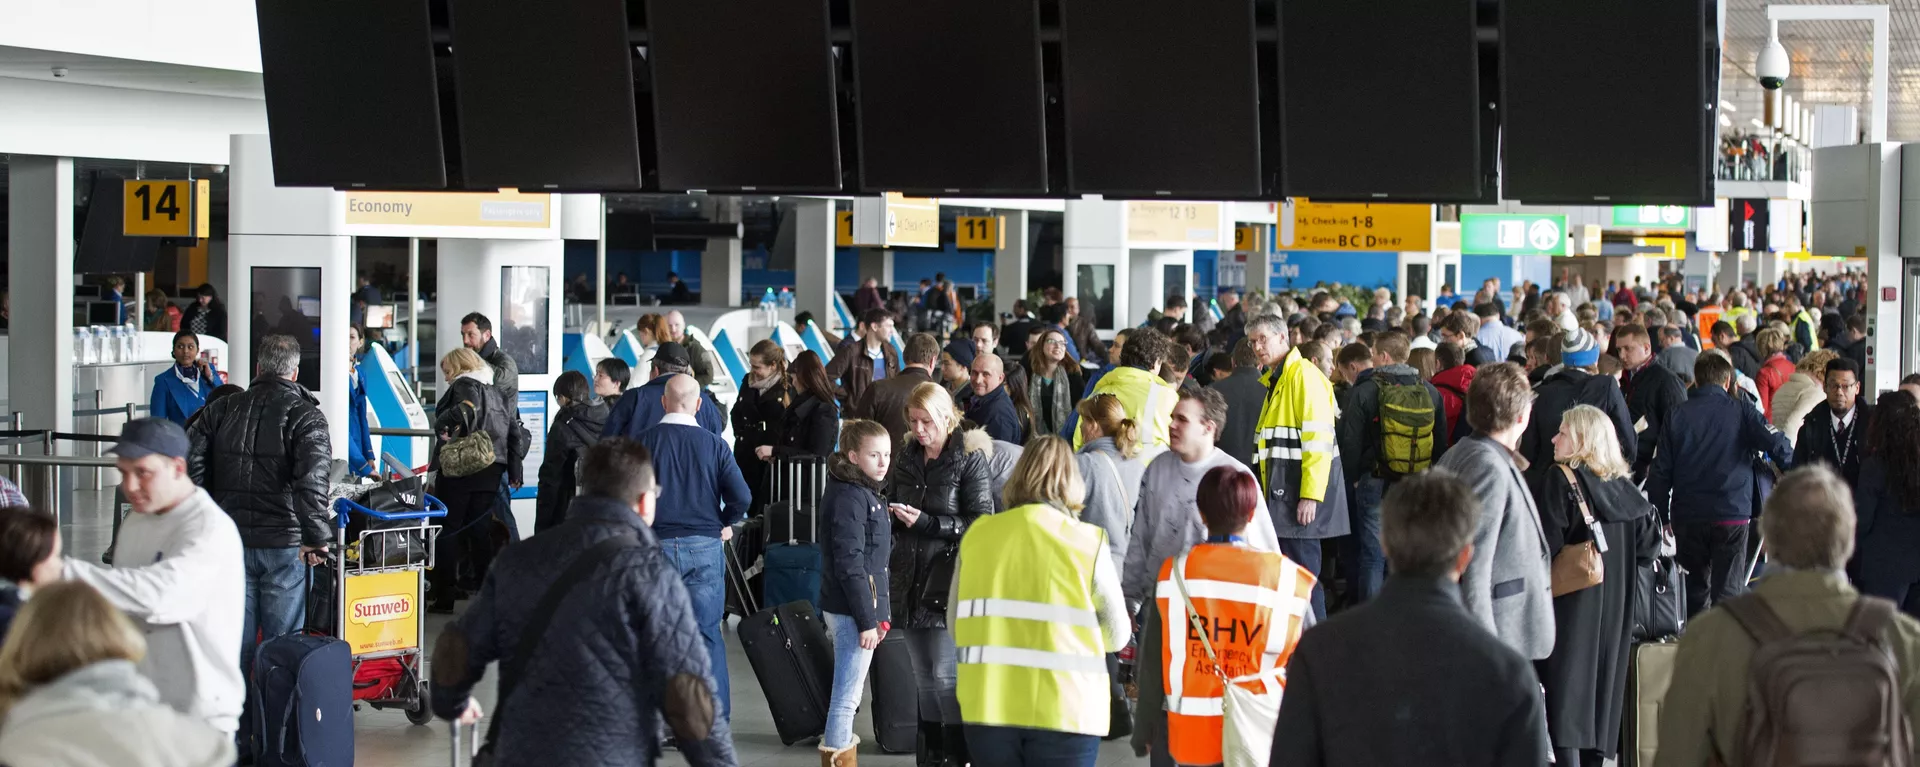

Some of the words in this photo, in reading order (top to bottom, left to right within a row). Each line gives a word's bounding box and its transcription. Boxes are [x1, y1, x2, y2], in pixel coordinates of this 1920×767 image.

[134, 184, 180, 221] 14
[349, 198, 412, 217] Economy
[965, 218, 988, 240] 11
[1311, 216, 1349, 226] Check-in
[1352, 215, 1374, 229] 1-8
[1311, 235, 1336, 245] Gates
[1338, 234, 1347, 247] B
[1350, 234, 1360, 248] C
[1366, 234, 1377, 248] D
[354, 598, 410, 618] Sunweb
[1188, 615, 1263, 647] BHV
[360, 637, 403, 650] www.sunweb.nl
